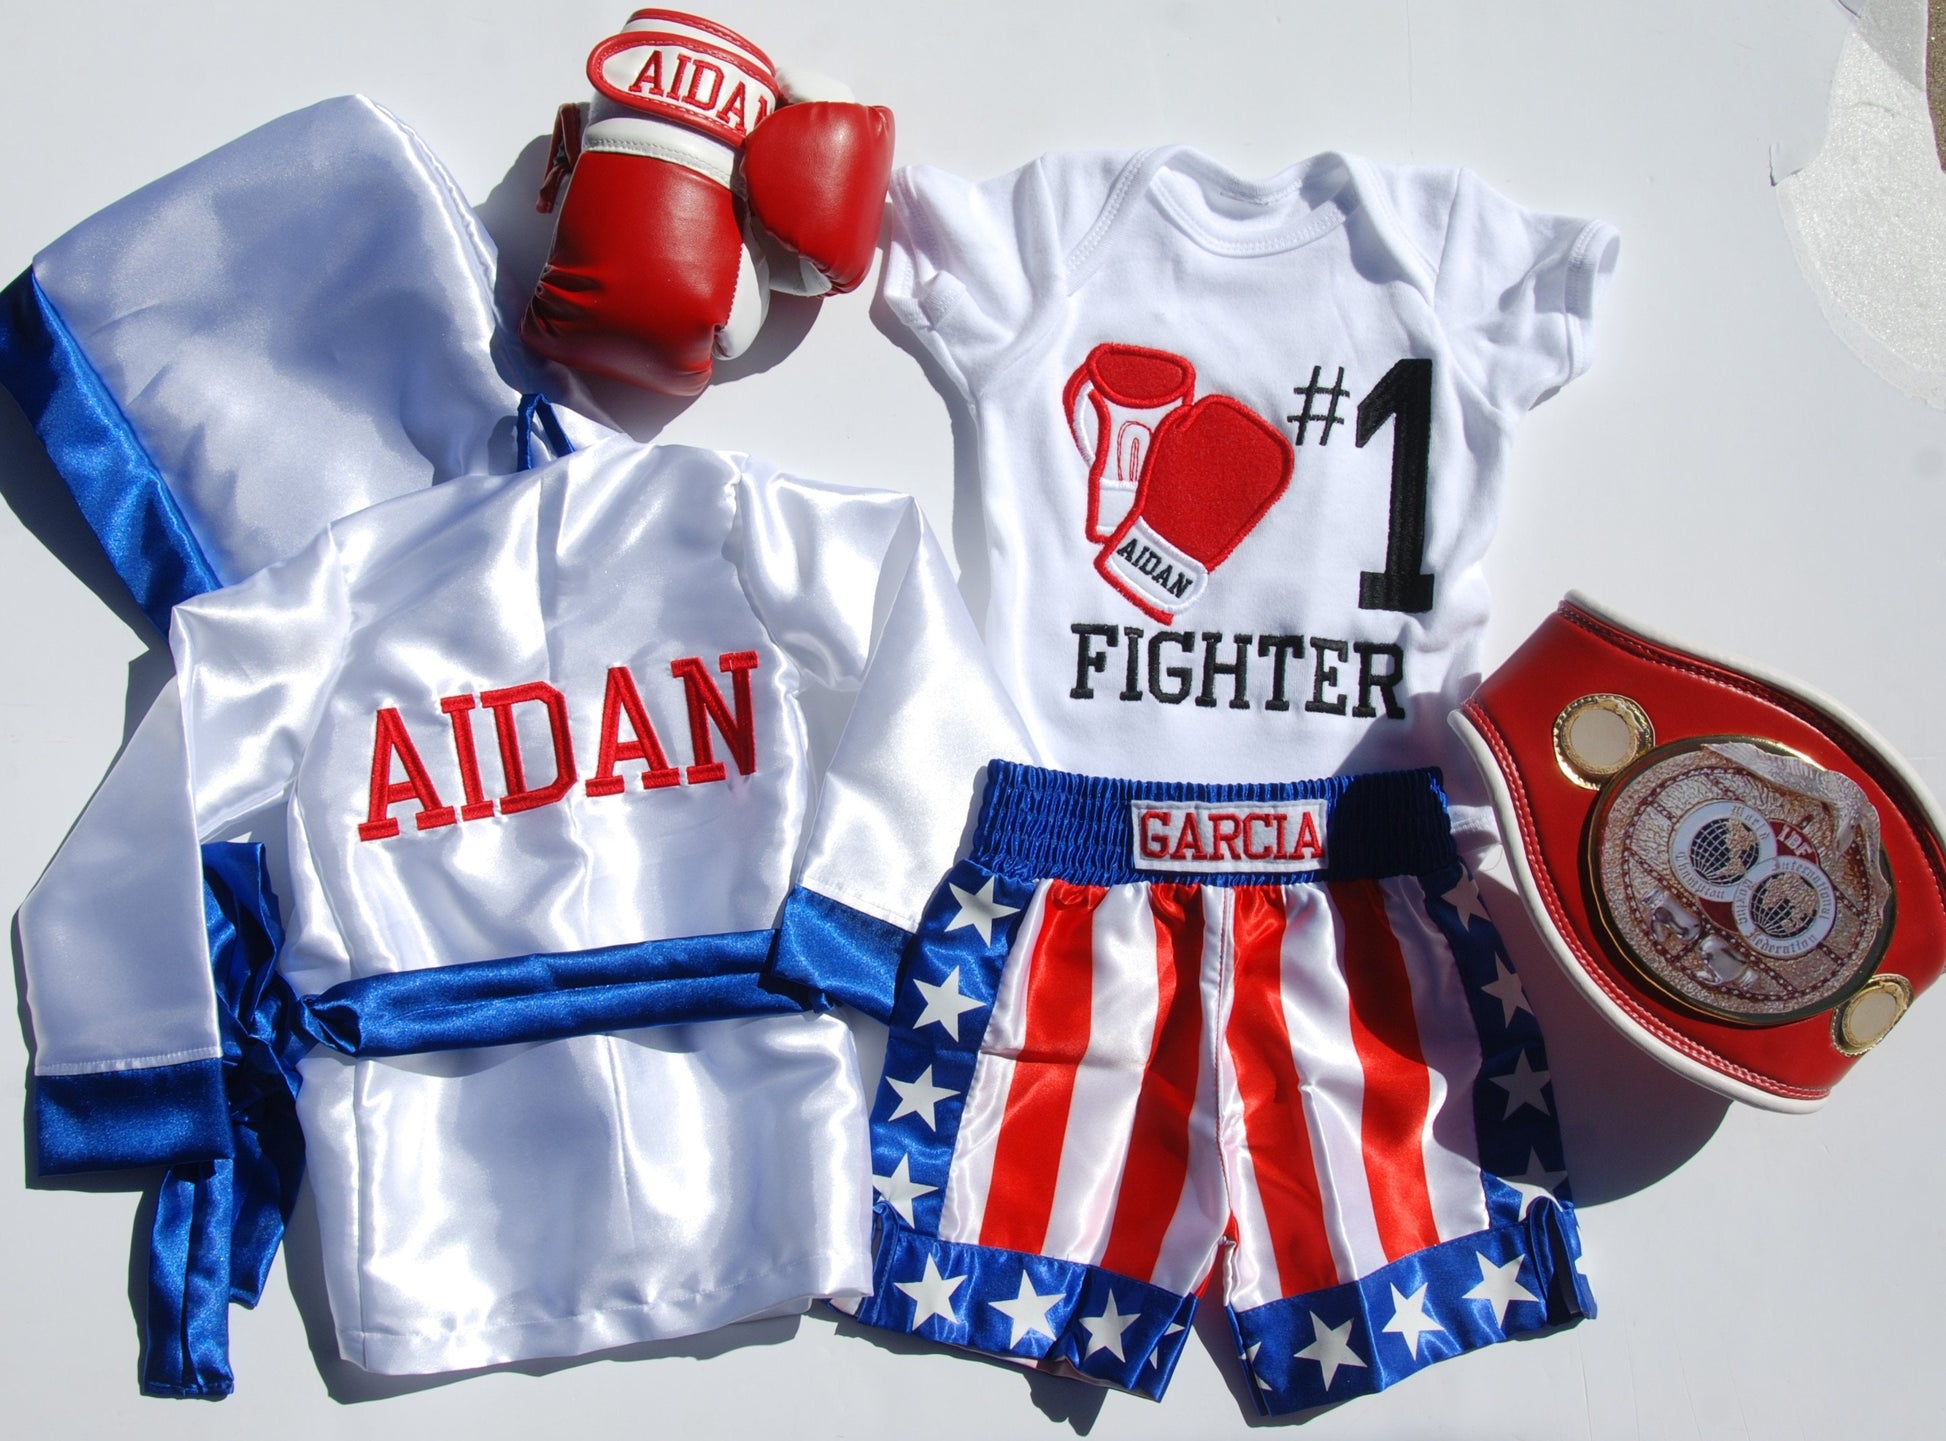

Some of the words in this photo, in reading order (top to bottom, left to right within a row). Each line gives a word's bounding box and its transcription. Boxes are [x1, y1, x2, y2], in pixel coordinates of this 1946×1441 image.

[1287, 358, 1434, 613] #1
[1116, 537, 1194, 599] AIDAN
[1070, 623, 1405, 720] FIGHTER
[358, 650, 759, 842] AIDAN
[1140, 811, 1325, 860] GARCIA
